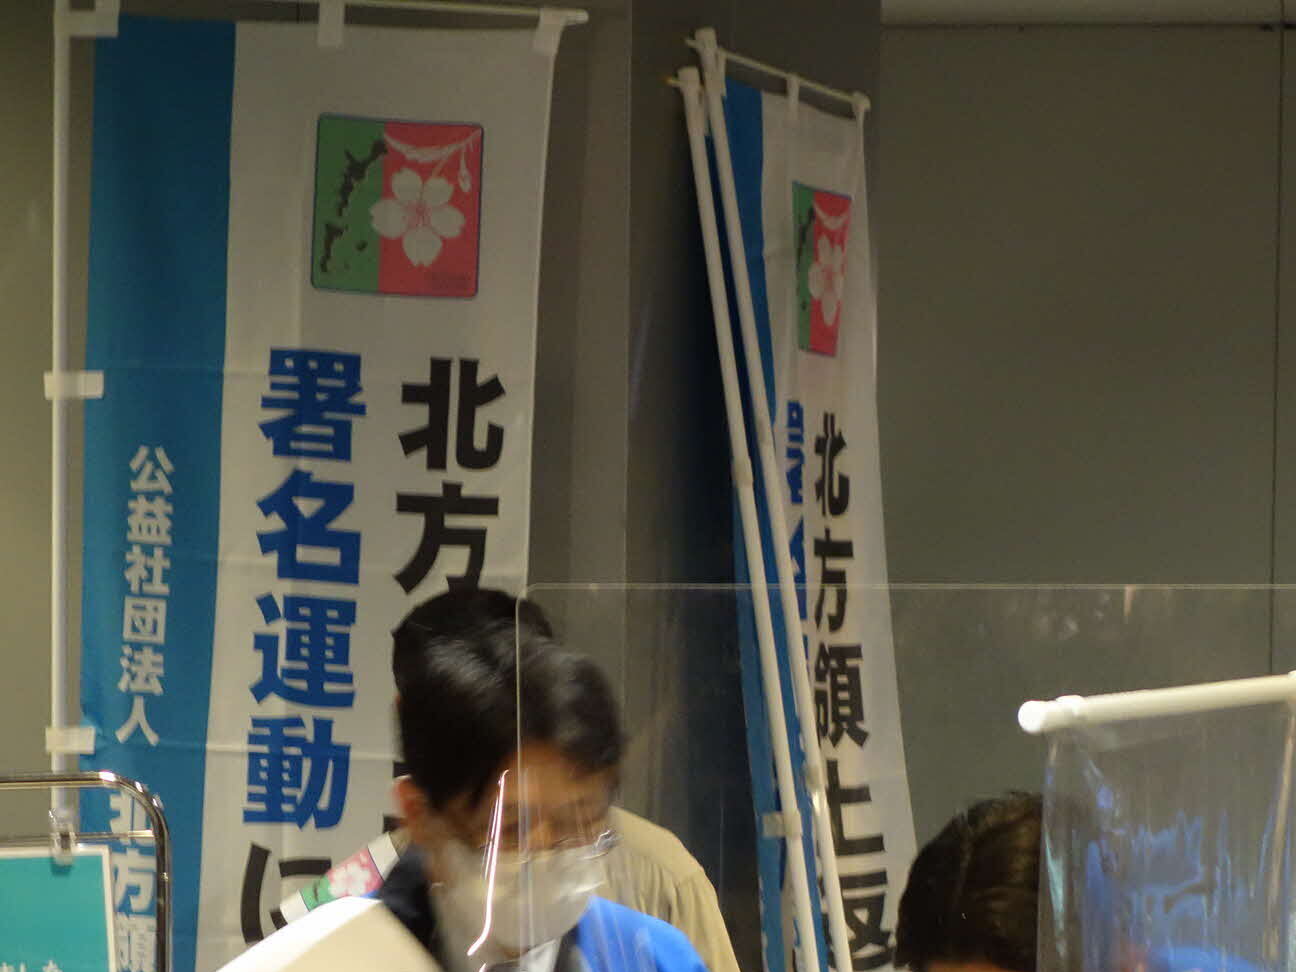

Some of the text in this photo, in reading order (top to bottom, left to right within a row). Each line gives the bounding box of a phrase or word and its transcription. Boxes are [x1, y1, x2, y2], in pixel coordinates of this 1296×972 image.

[115, 445, 174, 747] 公益社団法人
